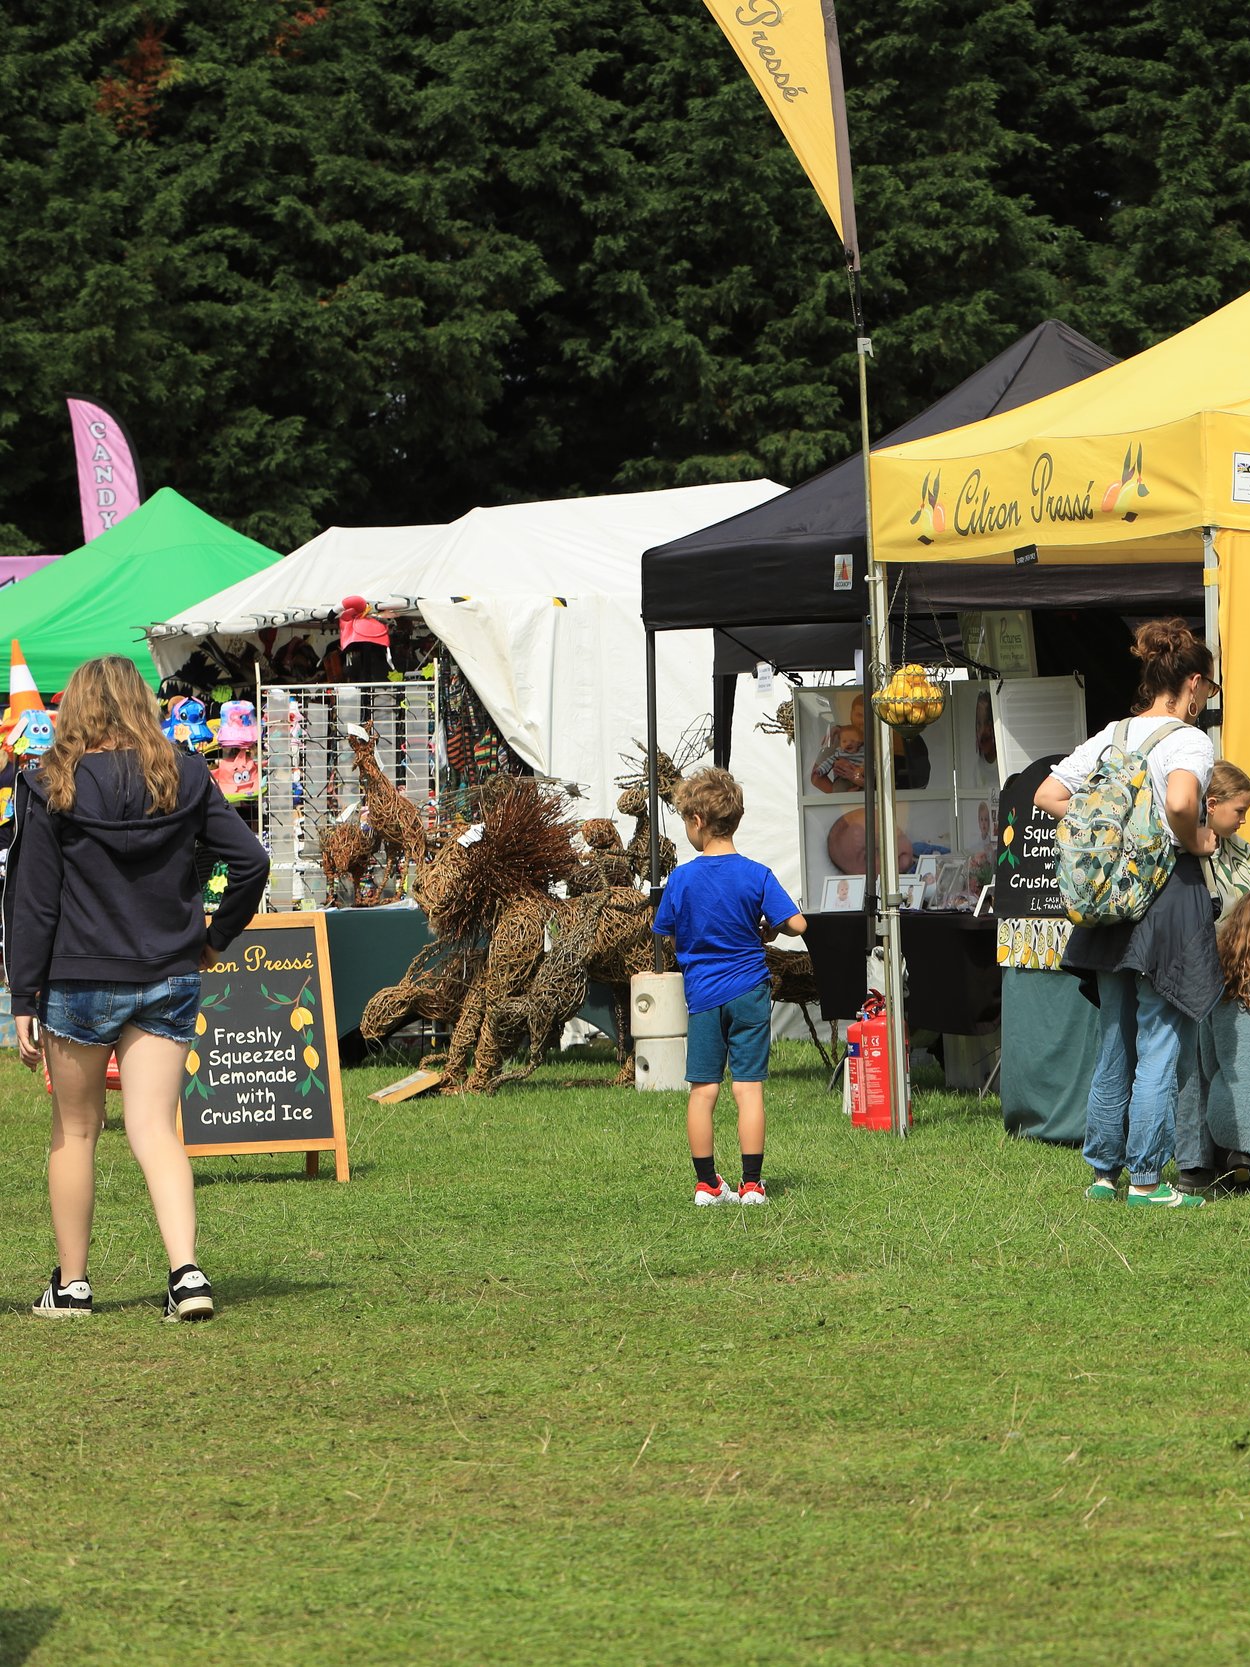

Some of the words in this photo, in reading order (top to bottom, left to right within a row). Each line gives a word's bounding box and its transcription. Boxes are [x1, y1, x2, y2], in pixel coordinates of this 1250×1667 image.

[735, 0, 809, 103] Pressé
[89, 421, 117, 530] CANDY
[954, 468, 1022, 536] Citron
[1030, 452, 1095, 523] Pressé
[1023, 826, 1056, 843] Sque
[1023, 843, 1056, 858] Lemo
[1010, 873, 1058, 889] Crushe
[1030, 897, 1042, 911] £4
[244, 945, 314, 972] Pressé
[214, 1026, 282, 1047] Freshly
[209, 1045, 296, 1069] Squeezed
[208, 1068, 297, 1086] Lemonade
[236, 1087, 276, 1105] with
[201, 1104, 275, 1125] Crushed
[281, 1104, 313, 1121] Ice
